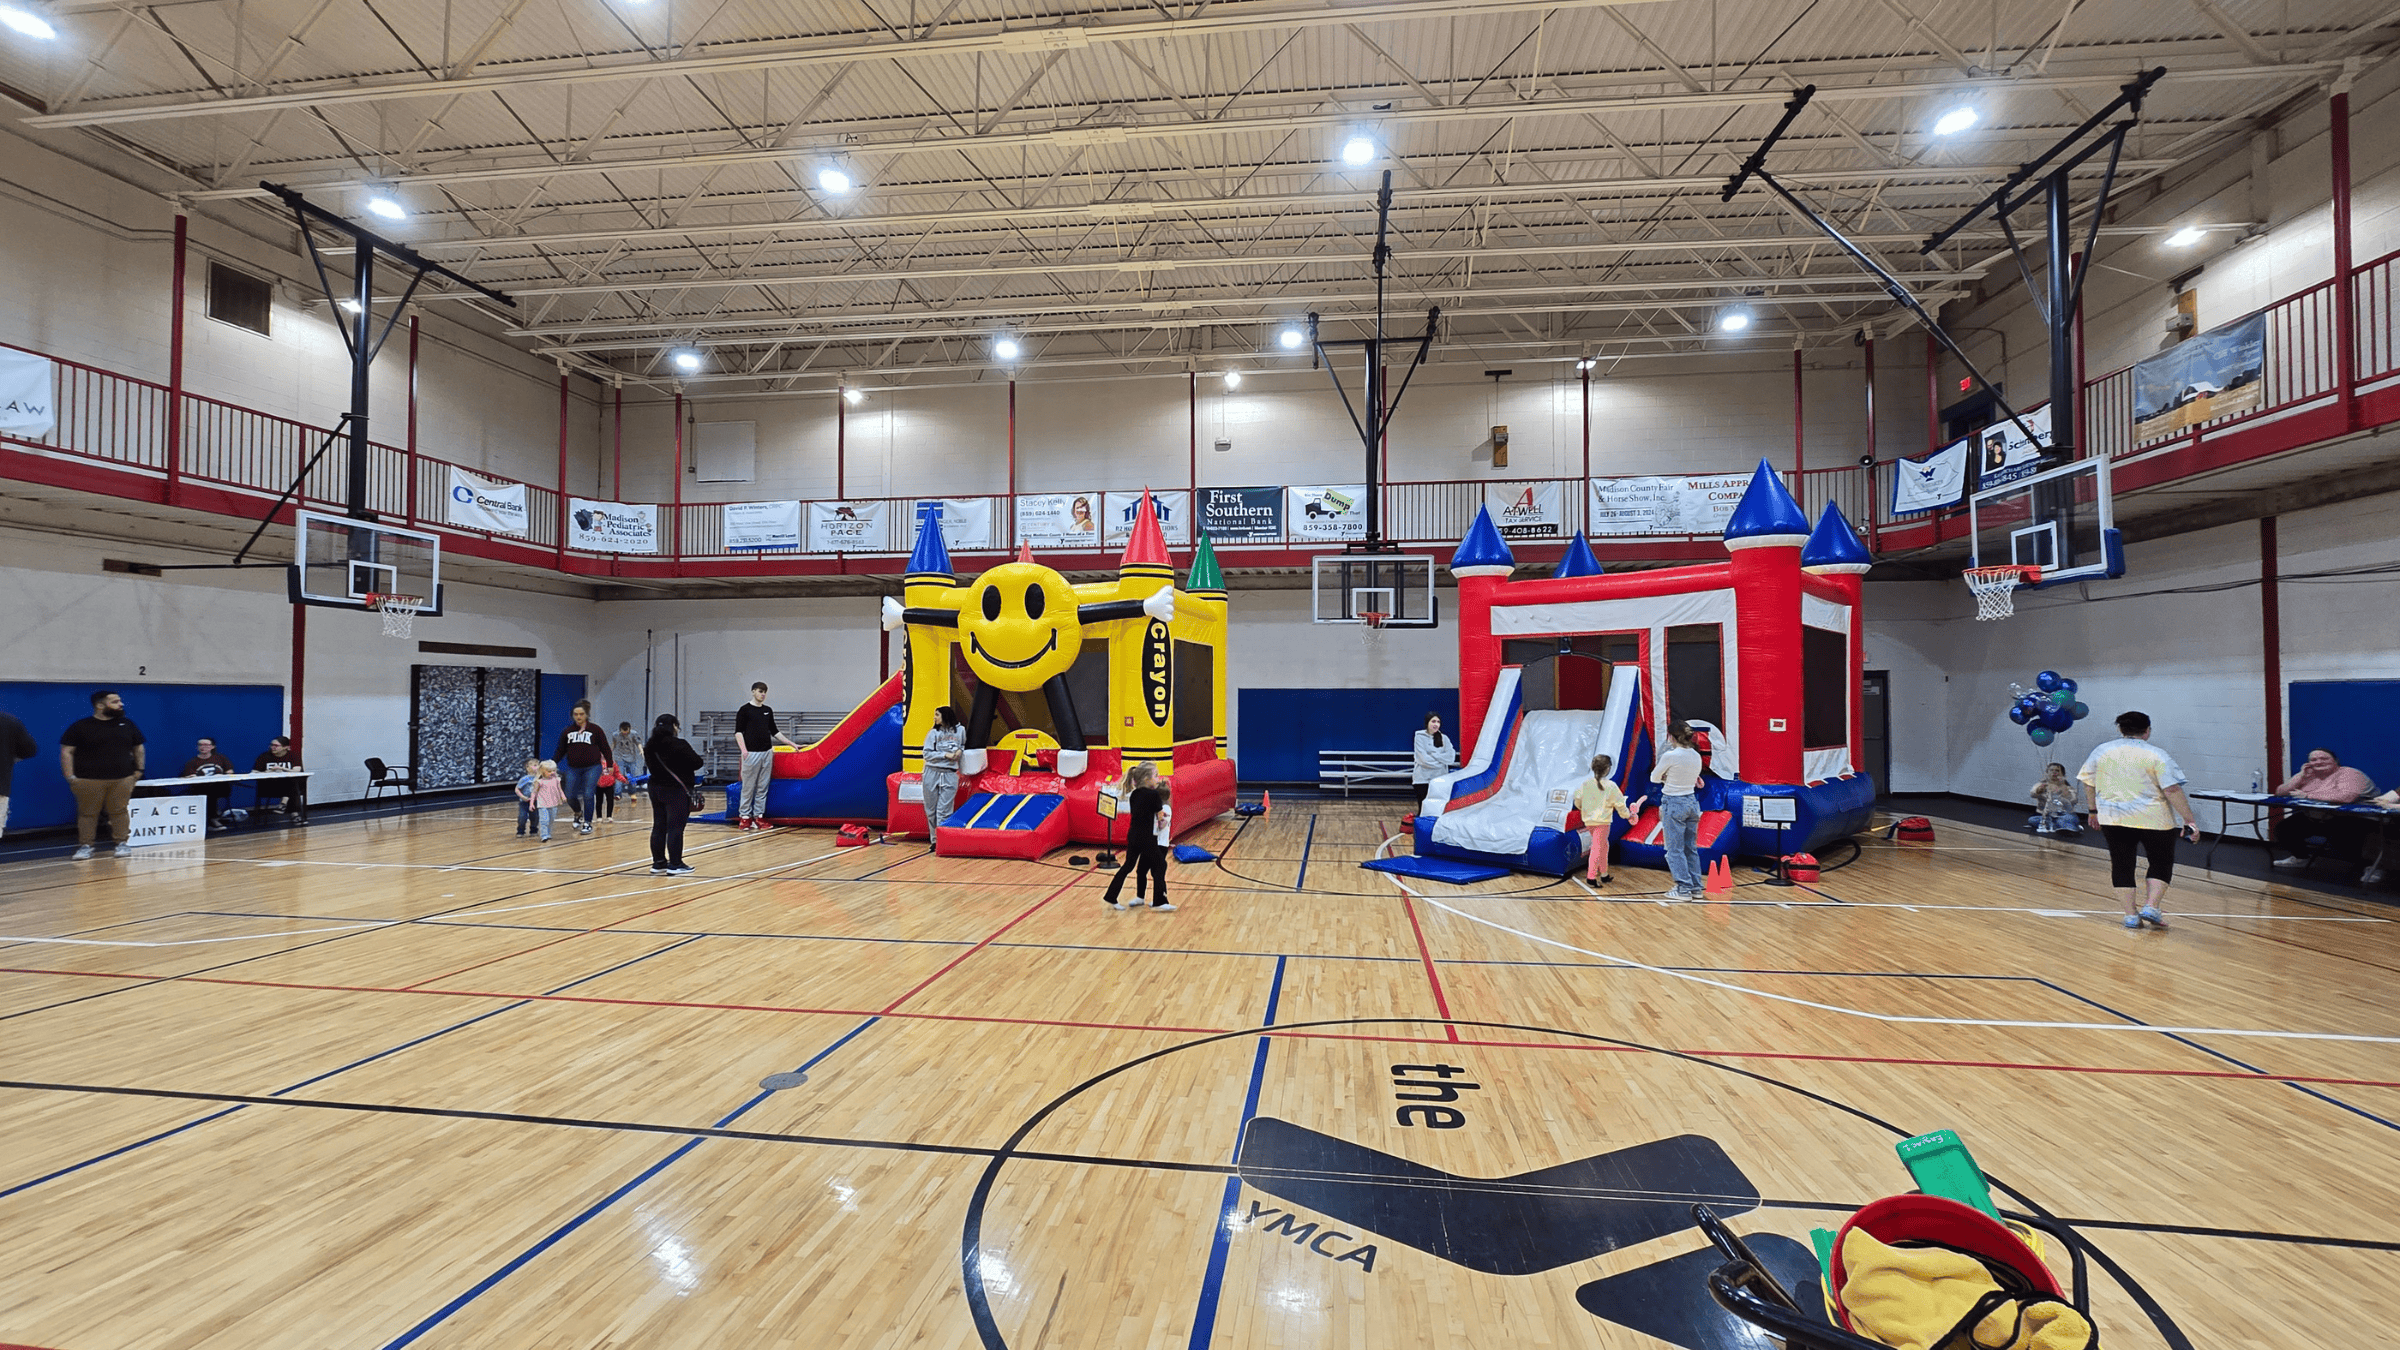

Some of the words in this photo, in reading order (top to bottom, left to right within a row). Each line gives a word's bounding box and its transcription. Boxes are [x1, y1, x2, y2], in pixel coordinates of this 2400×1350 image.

[1630, 484, 1658, 493] County
[1659, 483, 1674, 491] Fair
[1687, 480, 1720, 491] MILLS
[1209, 489, 1243, 503] First
[1324, 491, 1351, 511] Dump
[1607, 495, 1628, 503] Horse
[476, 495, 507, 510] Central
[506, 501, 523, 513] Bank
[1020, 499, 1046, 508] Stacey
[1205, 502, 1274, 517] Southern
[604, 513, 639, 523] Madison
[1207, 517, 1246, 526] National
[1250, 517, 1273, 525] Bank
[607, 521, 645, 530] Pediatric
[821, 522, 873, 530] HORIZON
[1303, 523, 1363, 531] 859-358-7800
[609, 528, 652, 537] Associates
[579, 533, 649, 544] 859-624-2020
[139, 665, 147, 676] 2
[1150, 622, 1167, 718] Crayon
[567, 731, 593, 745] PINK
[131, 805, 197, 818] FACE
[1391, 1064, 1481, 1129] the
[1243, 1200, 1378, 1274] YMCA
